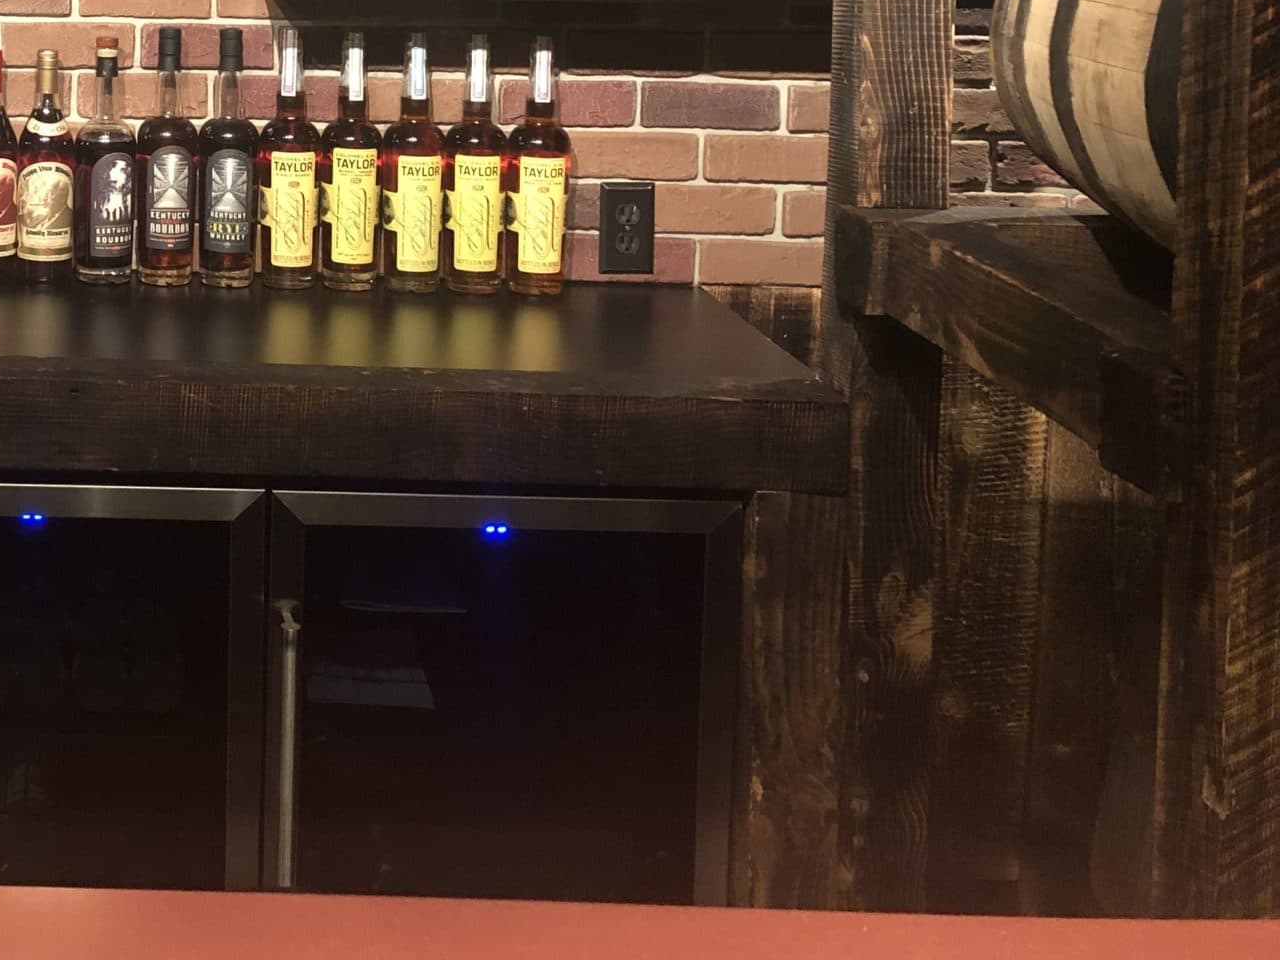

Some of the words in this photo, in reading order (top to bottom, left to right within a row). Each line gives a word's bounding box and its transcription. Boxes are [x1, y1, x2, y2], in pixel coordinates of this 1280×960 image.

[273, 160, 313, 173] TAYLOR
[335, 157, 376, 170] TAYLOR
[401, 165, 441, 177] TAYLOR
[457, 164, 499, 177] TAYLOR
[522, 166, 564, 179] TAYLOR
[150, 211, 190, 220] KENTUCKY
